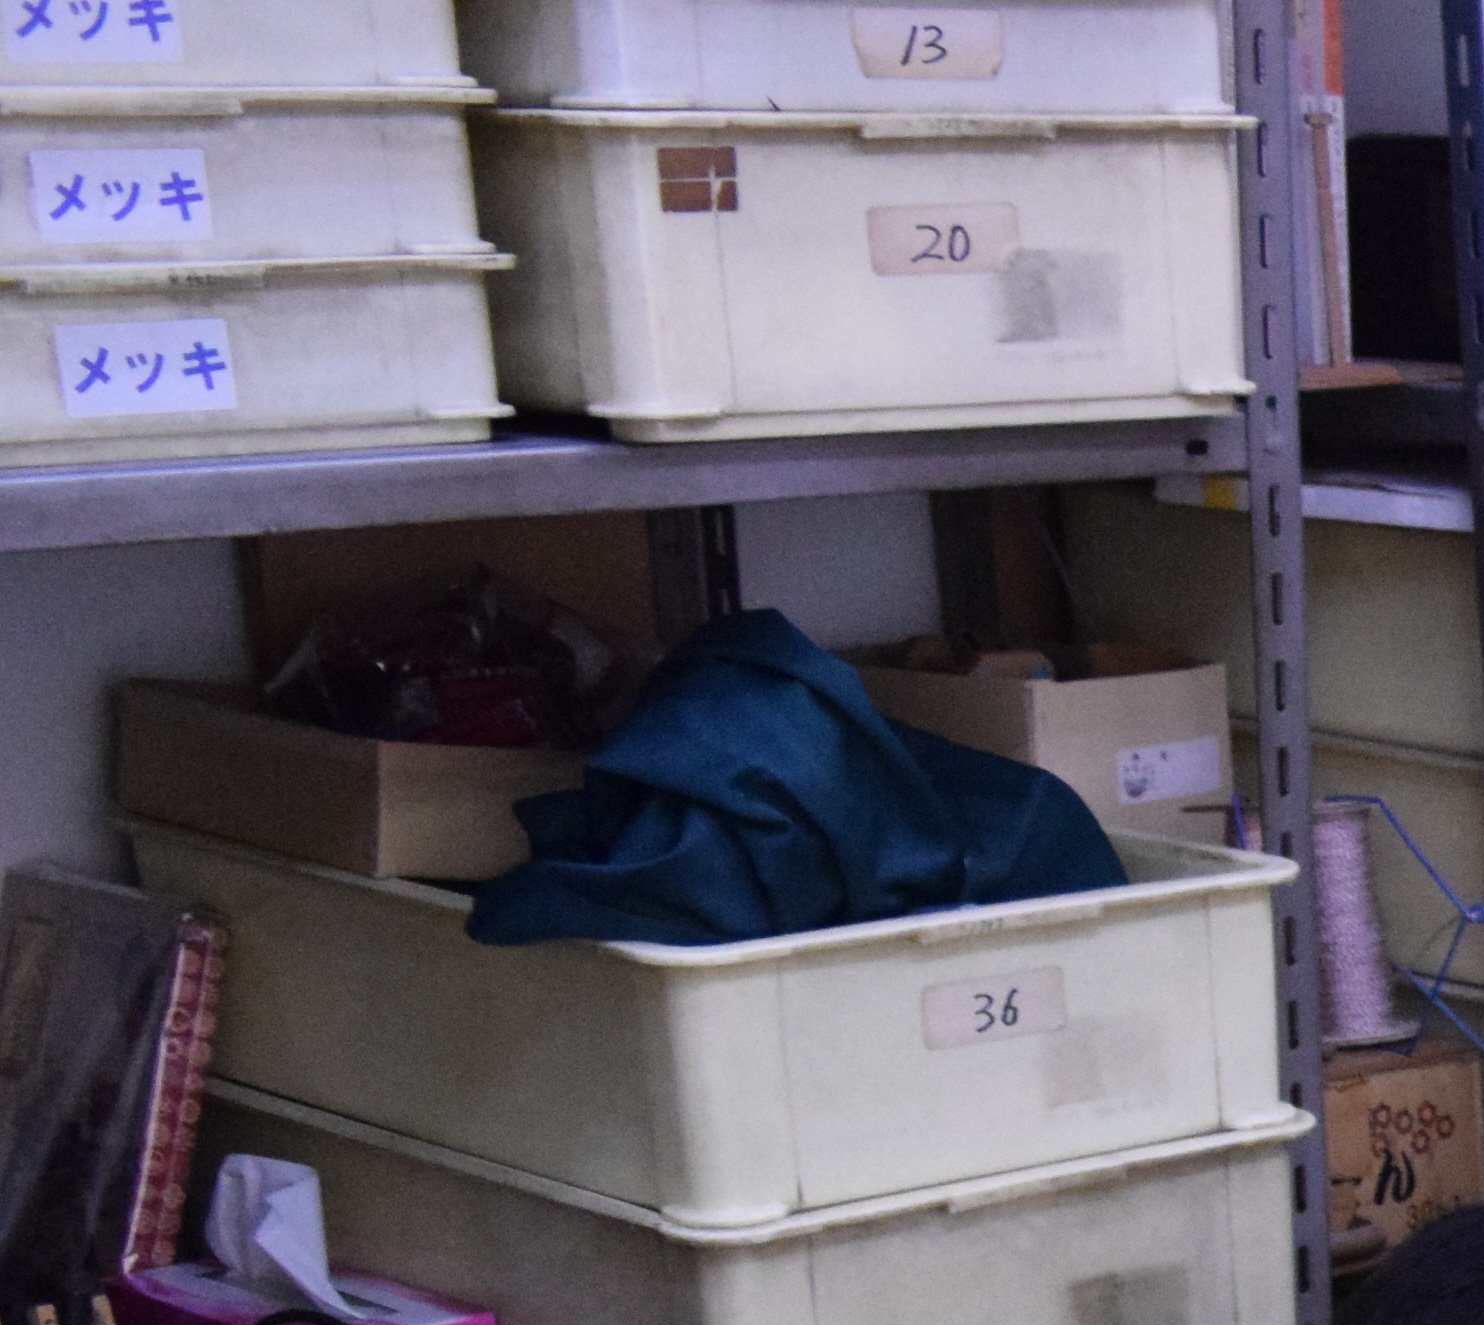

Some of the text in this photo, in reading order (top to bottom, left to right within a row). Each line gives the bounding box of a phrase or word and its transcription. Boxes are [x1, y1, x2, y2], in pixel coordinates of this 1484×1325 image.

[16, 0, 173, 42] メッキ
[901, 24, 948, 65] 13
[48, 173, 204, 221] メッキ
[914, 224, 972, 263] 20
[72, 344, 227, 395] メッキ
[972, 989, 1021, 1034] 36
